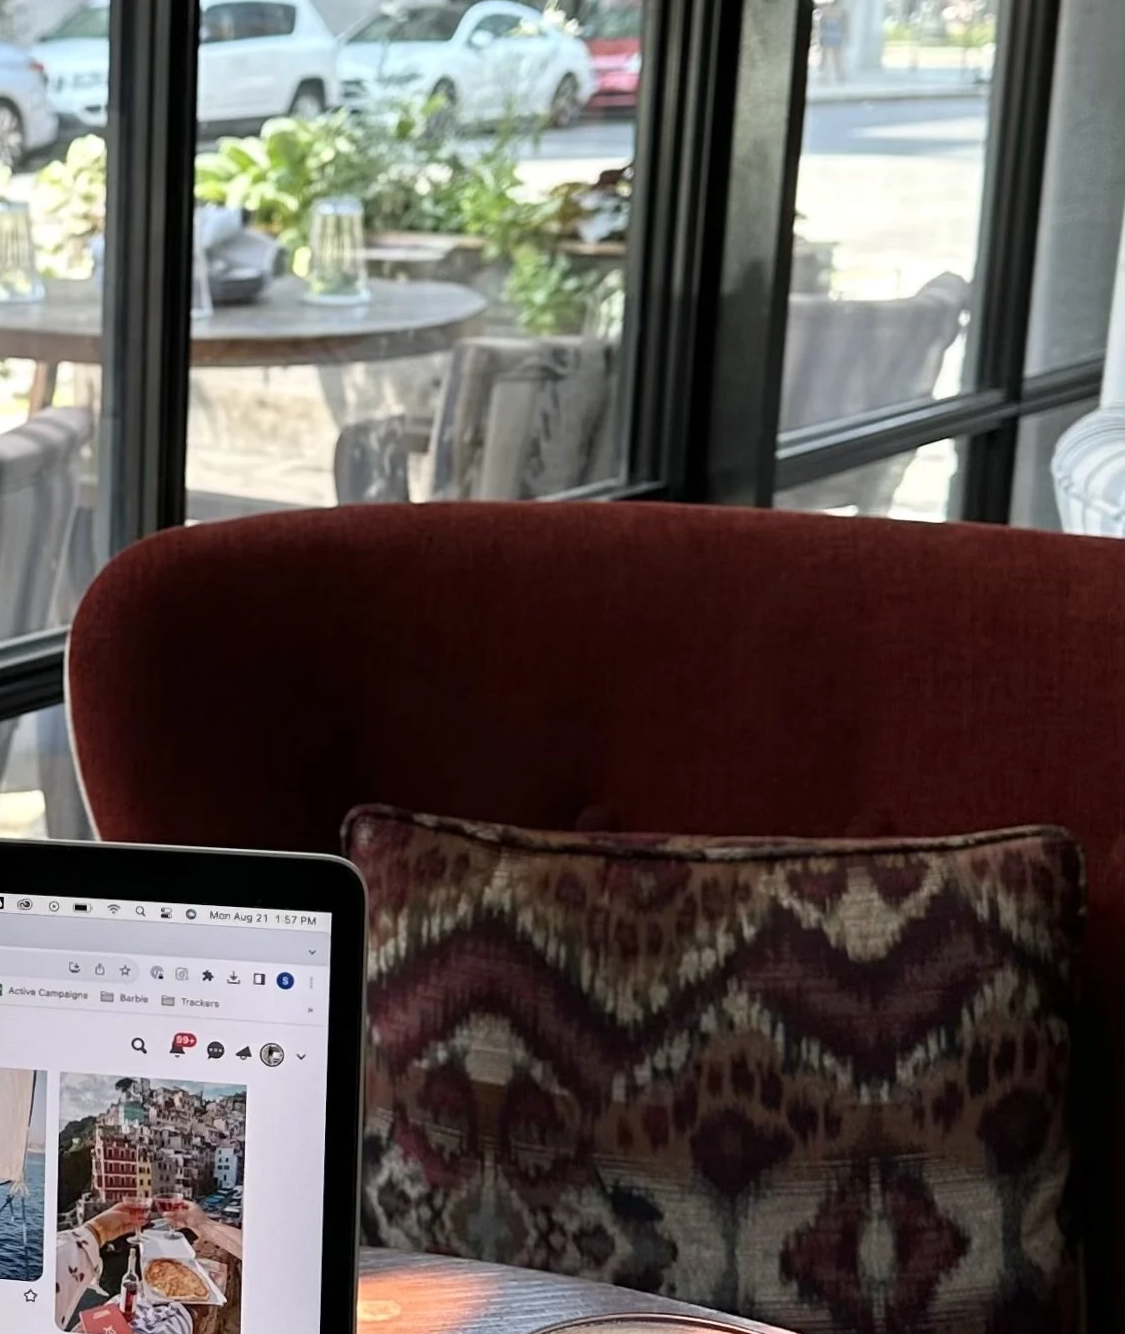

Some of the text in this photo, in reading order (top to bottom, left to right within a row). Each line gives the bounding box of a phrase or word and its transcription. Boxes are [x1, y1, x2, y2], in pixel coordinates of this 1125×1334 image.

[209, 910, 317, 926] Mon Aug 21 1:57 PM
[8, 985, 89, 1002] Active Campaigns
[120, 994, 149, 1004] Barbie
[181, 997, 219, 1009] Trackers
[175, 1035, 195, 1045] 99+
